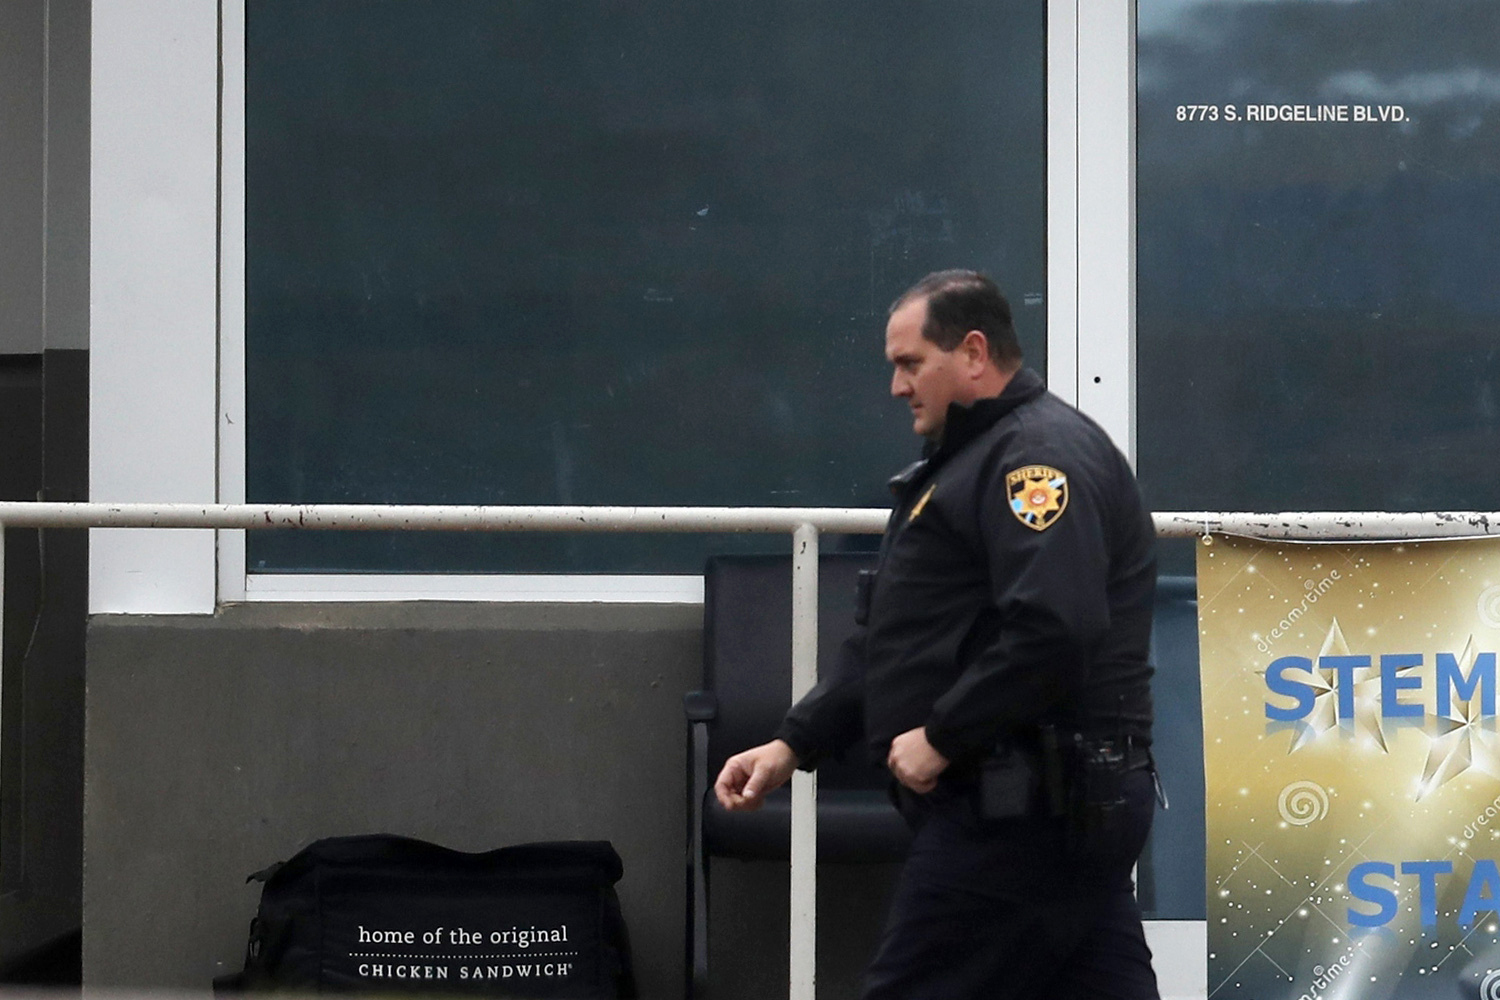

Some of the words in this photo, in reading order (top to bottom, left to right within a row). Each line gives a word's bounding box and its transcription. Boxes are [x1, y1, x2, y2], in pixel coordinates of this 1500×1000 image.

[1176, 104, 1219, 122] 8773
[1223, 104, 1242, 122] S.
[1246, 104, 1349, 122] RIDGELINE
[1353, 105, 1410, 122] BLVD.
[1257, 568, 1342, 653] dreamstime
[1265, 653, 1496, 721] STEM
[358, 926, 415, 944] home
[422, 927, 444, 945] of
[450, 927, 483, 945] the
[490, 925, 568, 949] original
[358, 964, 448, 979] CHICKEN
